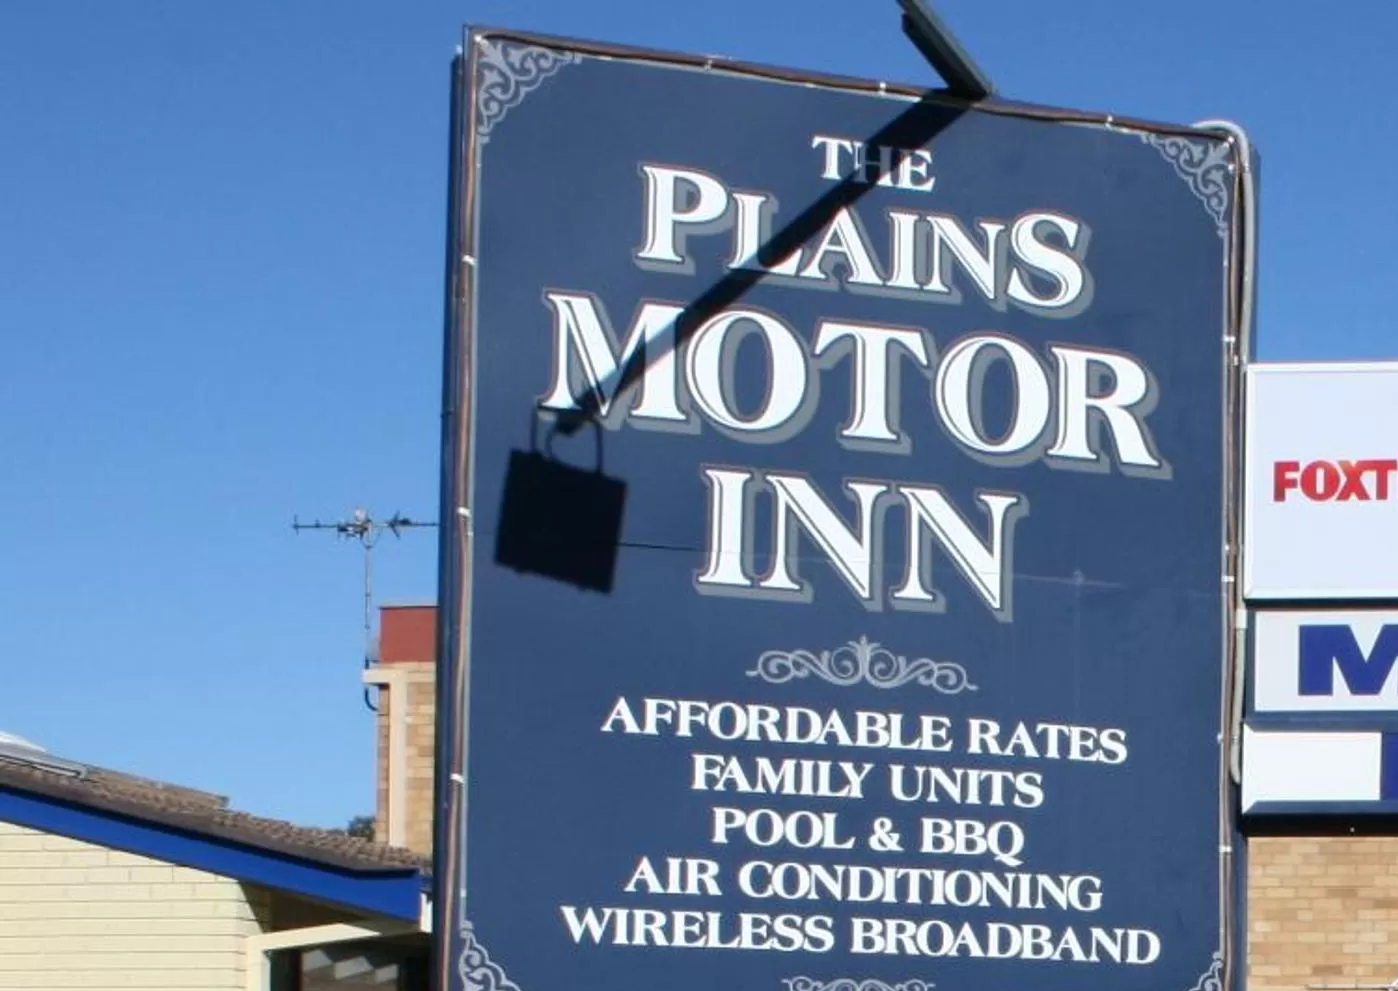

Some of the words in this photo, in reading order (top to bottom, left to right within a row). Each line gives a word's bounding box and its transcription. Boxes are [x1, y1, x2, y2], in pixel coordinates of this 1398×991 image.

[812, 133, 937, 194] THE
[634, 161, 1091, 316] PLAINS
[536, 287, 1171, 476] MOTOR
[694, 464, 1028, 621] INN
[600, 695, 954, 754] AFFORDABLE
[966, 717, 1128, 765] RATES
[690, 753, 875, 801] FAMILY
[889, 764, 1045, 809] UNITS
[710, 808, 856, 853] POOL
[870, 818, 904, 854] &
[920, 817, 1026, 867] BBQ
[624, 856, 722, 897] AIR
[737, 860, 1104, 913] CONDITIONING
[559, 904, 836, 954] WIRELESS
[849, 918, 1161, 966] BROADBAND
